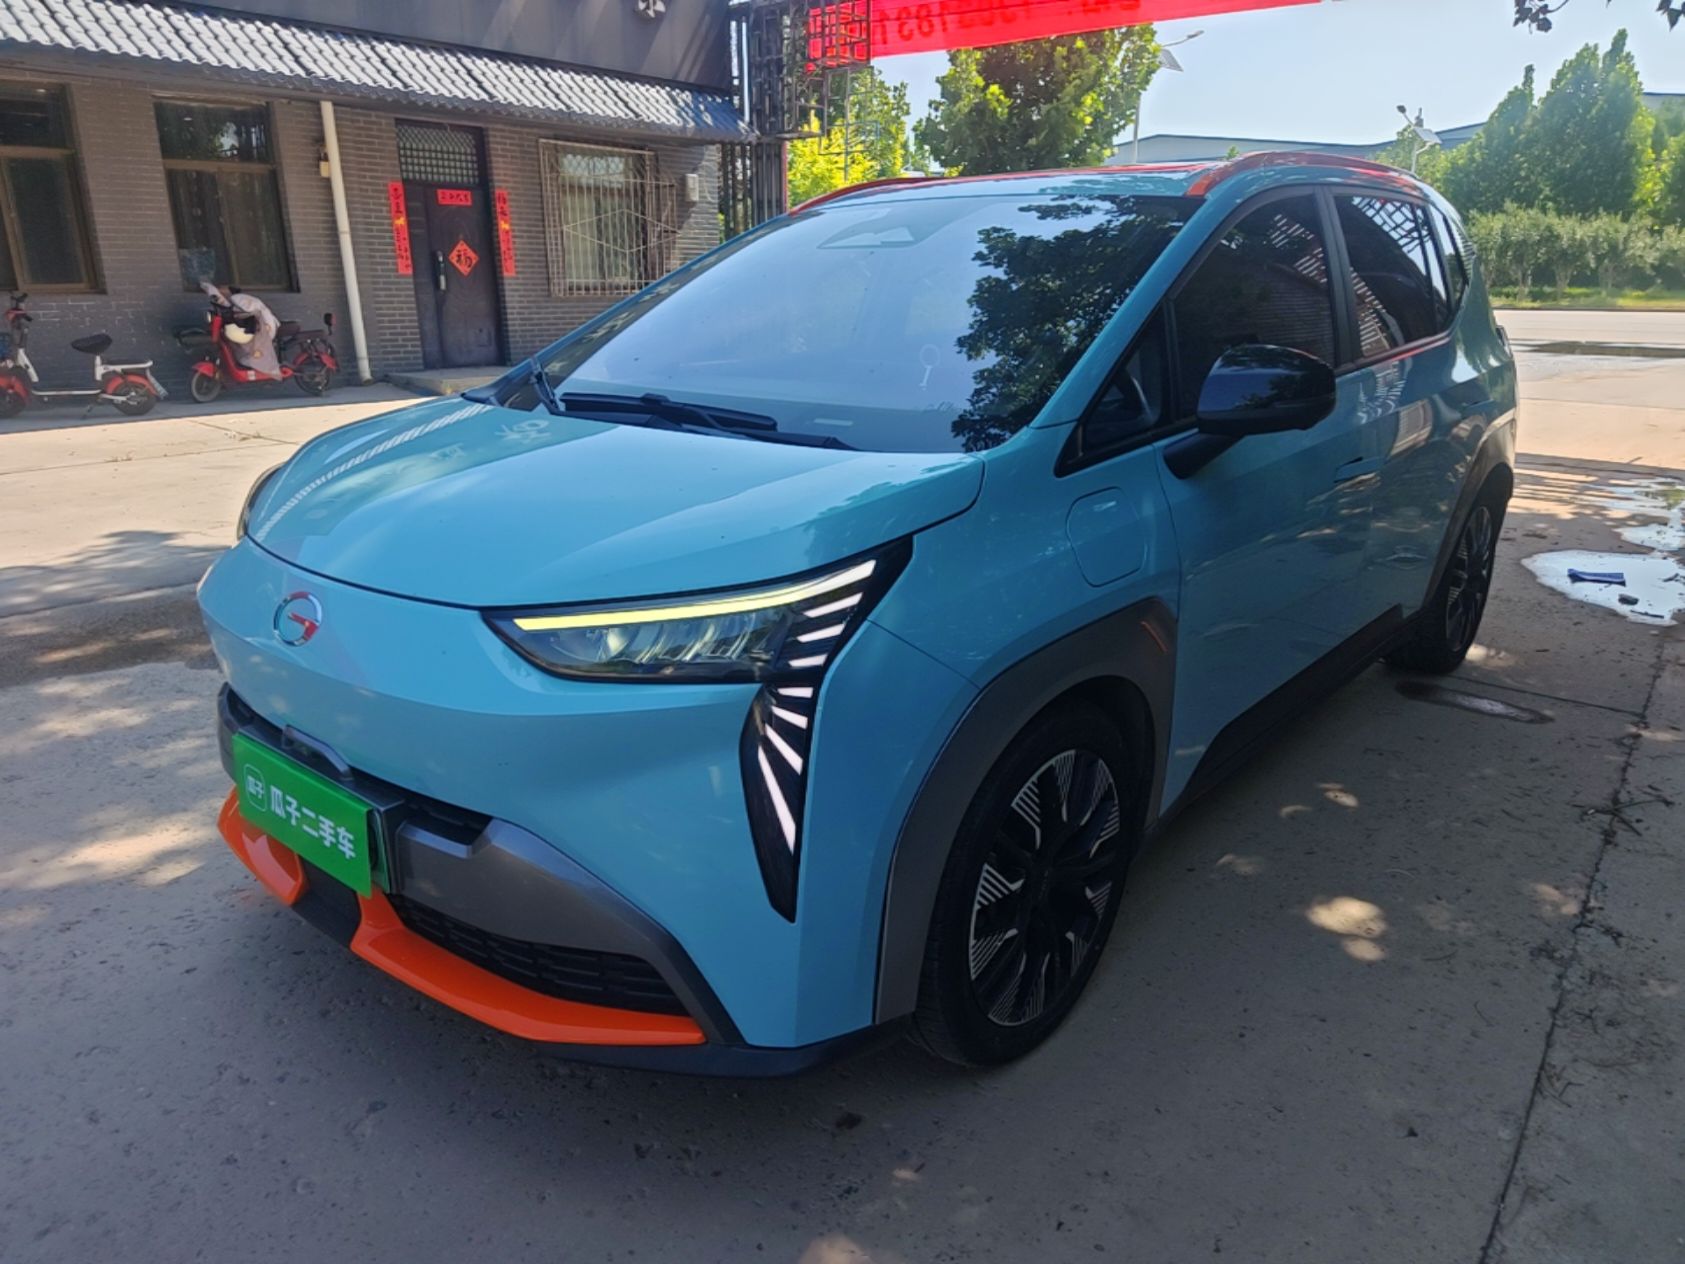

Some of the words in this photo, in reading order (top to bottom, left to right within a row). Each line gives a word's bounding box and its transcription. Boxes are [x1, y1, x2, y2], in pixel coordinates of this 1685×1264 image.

[270, 785, 356, 860] 瓜子二手车
